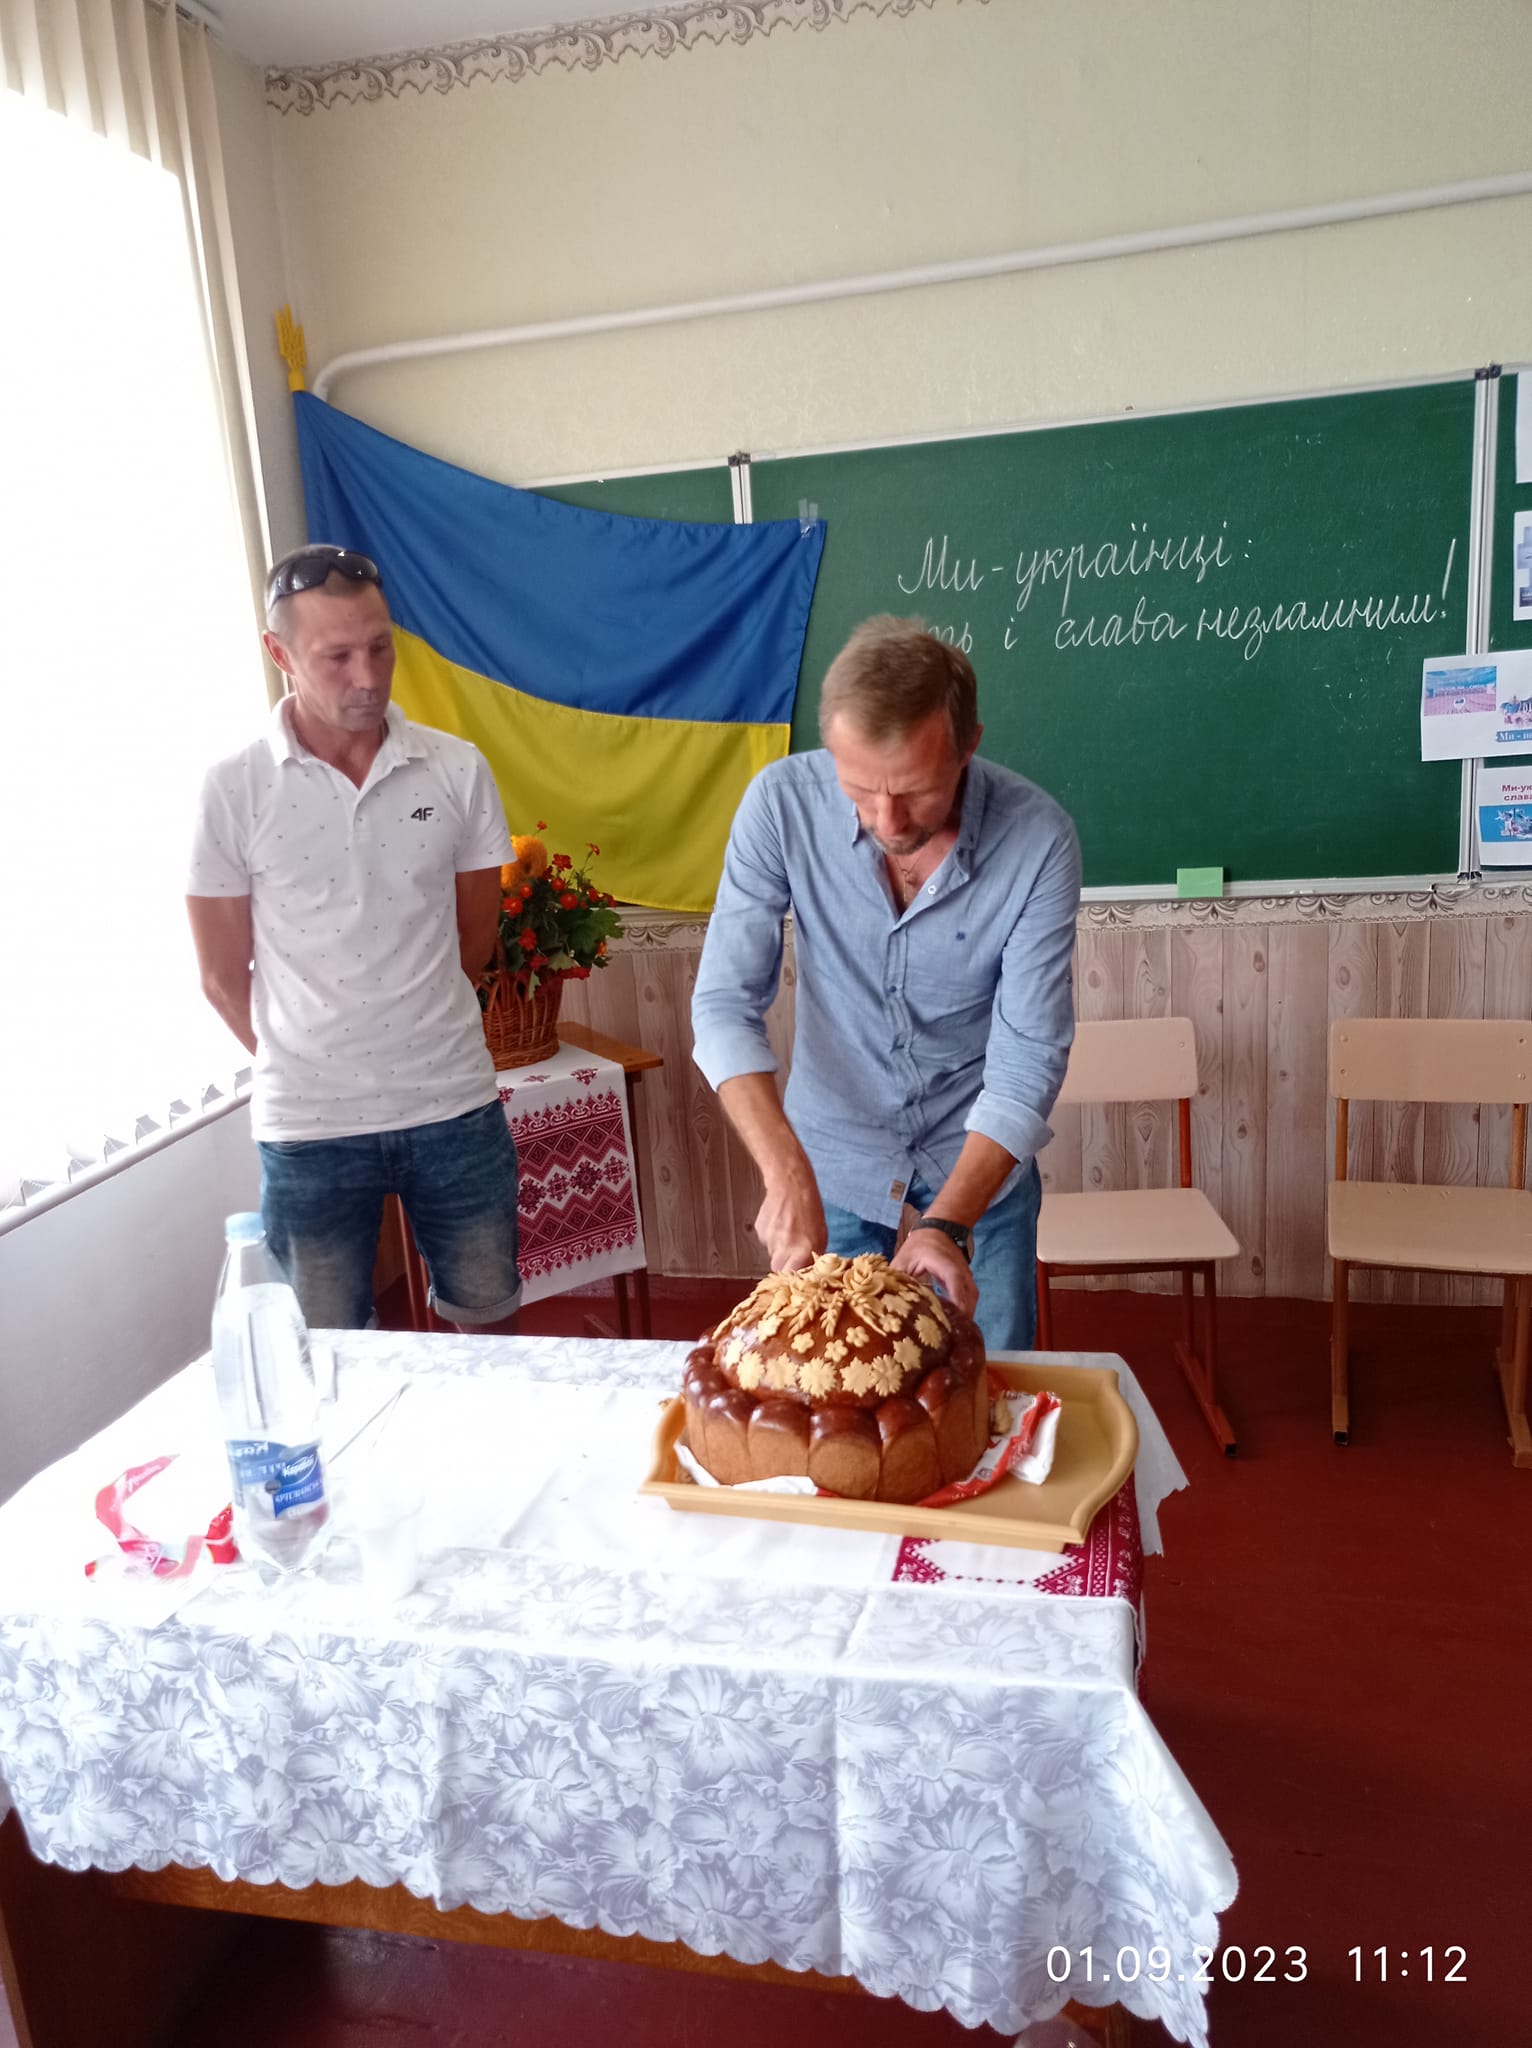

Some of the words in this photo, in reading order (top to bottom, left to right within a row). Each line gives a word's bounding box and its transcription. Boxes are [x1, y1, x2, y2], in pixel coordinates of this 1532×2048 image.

[1004, 616, 1018, 650] і
[1055, 596, 1188, 650] слава
[410, 807, 434, 821] 4F
